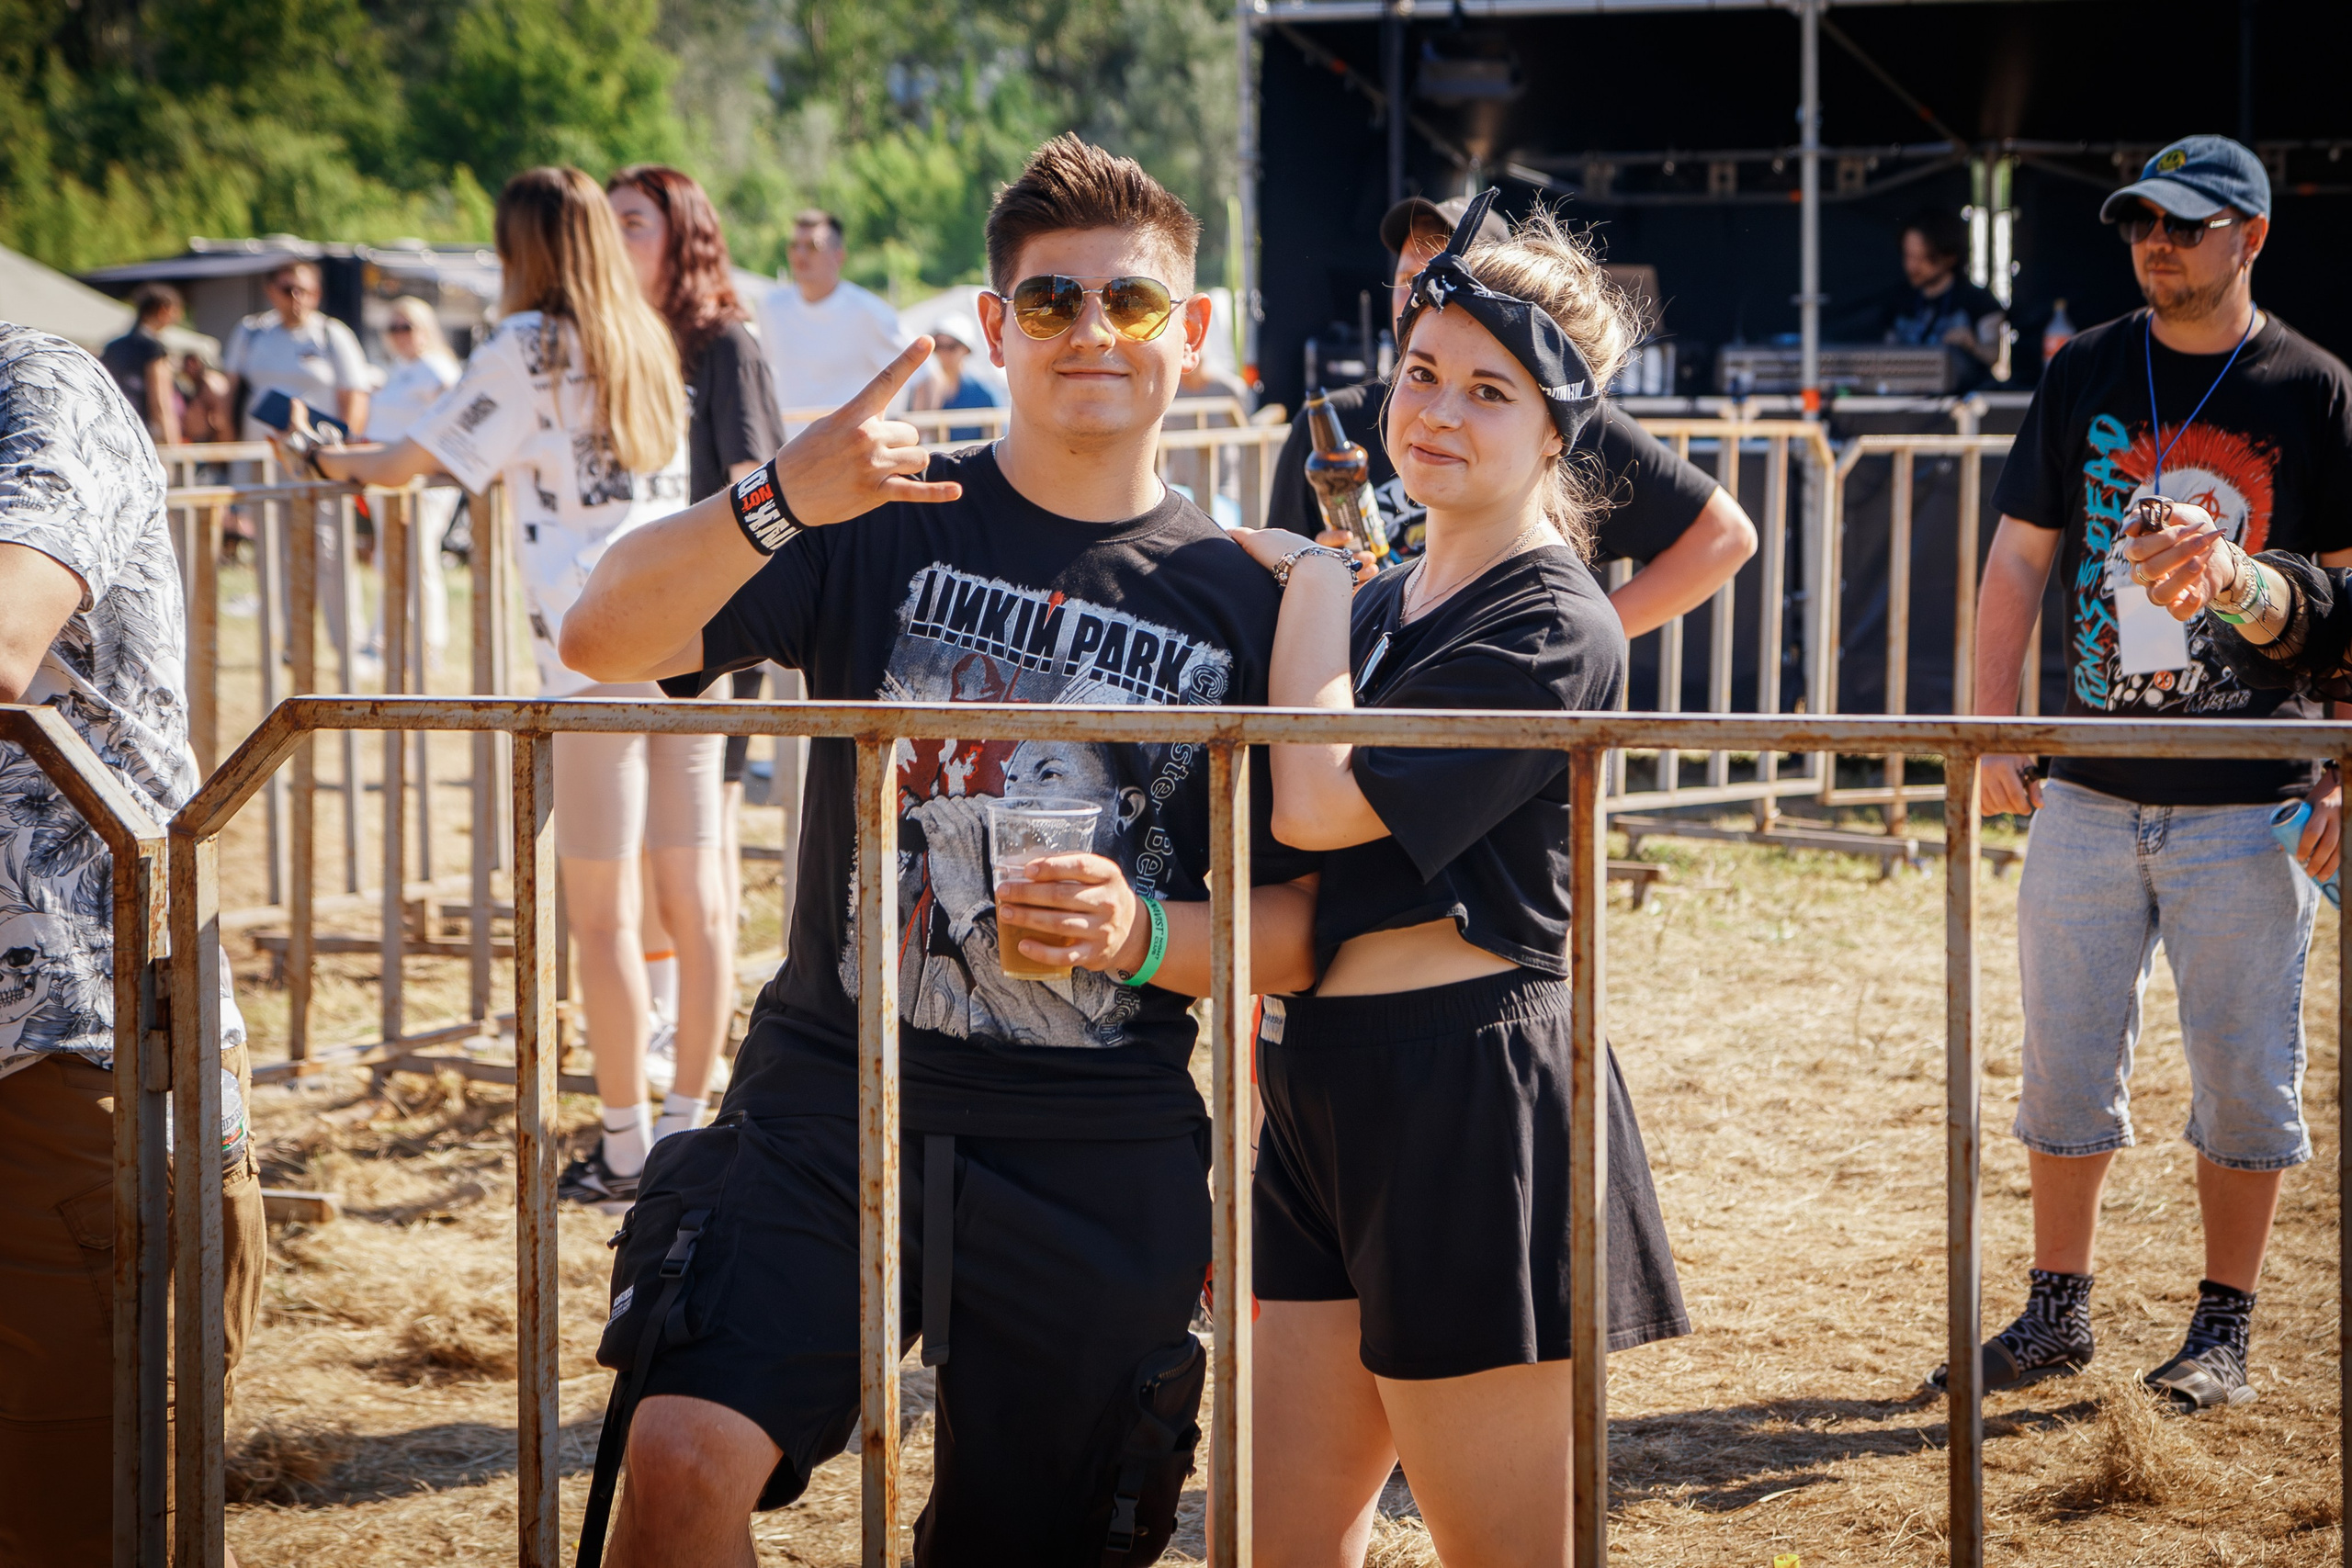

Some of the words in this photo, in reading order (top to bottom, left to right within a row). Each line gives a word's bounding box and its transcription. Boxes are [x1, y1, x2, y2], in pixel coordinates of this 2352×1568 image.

[741, 483, 775, 513] NOT
[2083, 412, 2142, 557] DEAD
[2074, 555, 2106, 595] NOT
[907, 569, 1066, 675] LINKIN
[1062, 611, 1195, 706] PARK
[1150, 664, 1225, 815] Cster
[1150, 935, 1159, 956] CLUB
